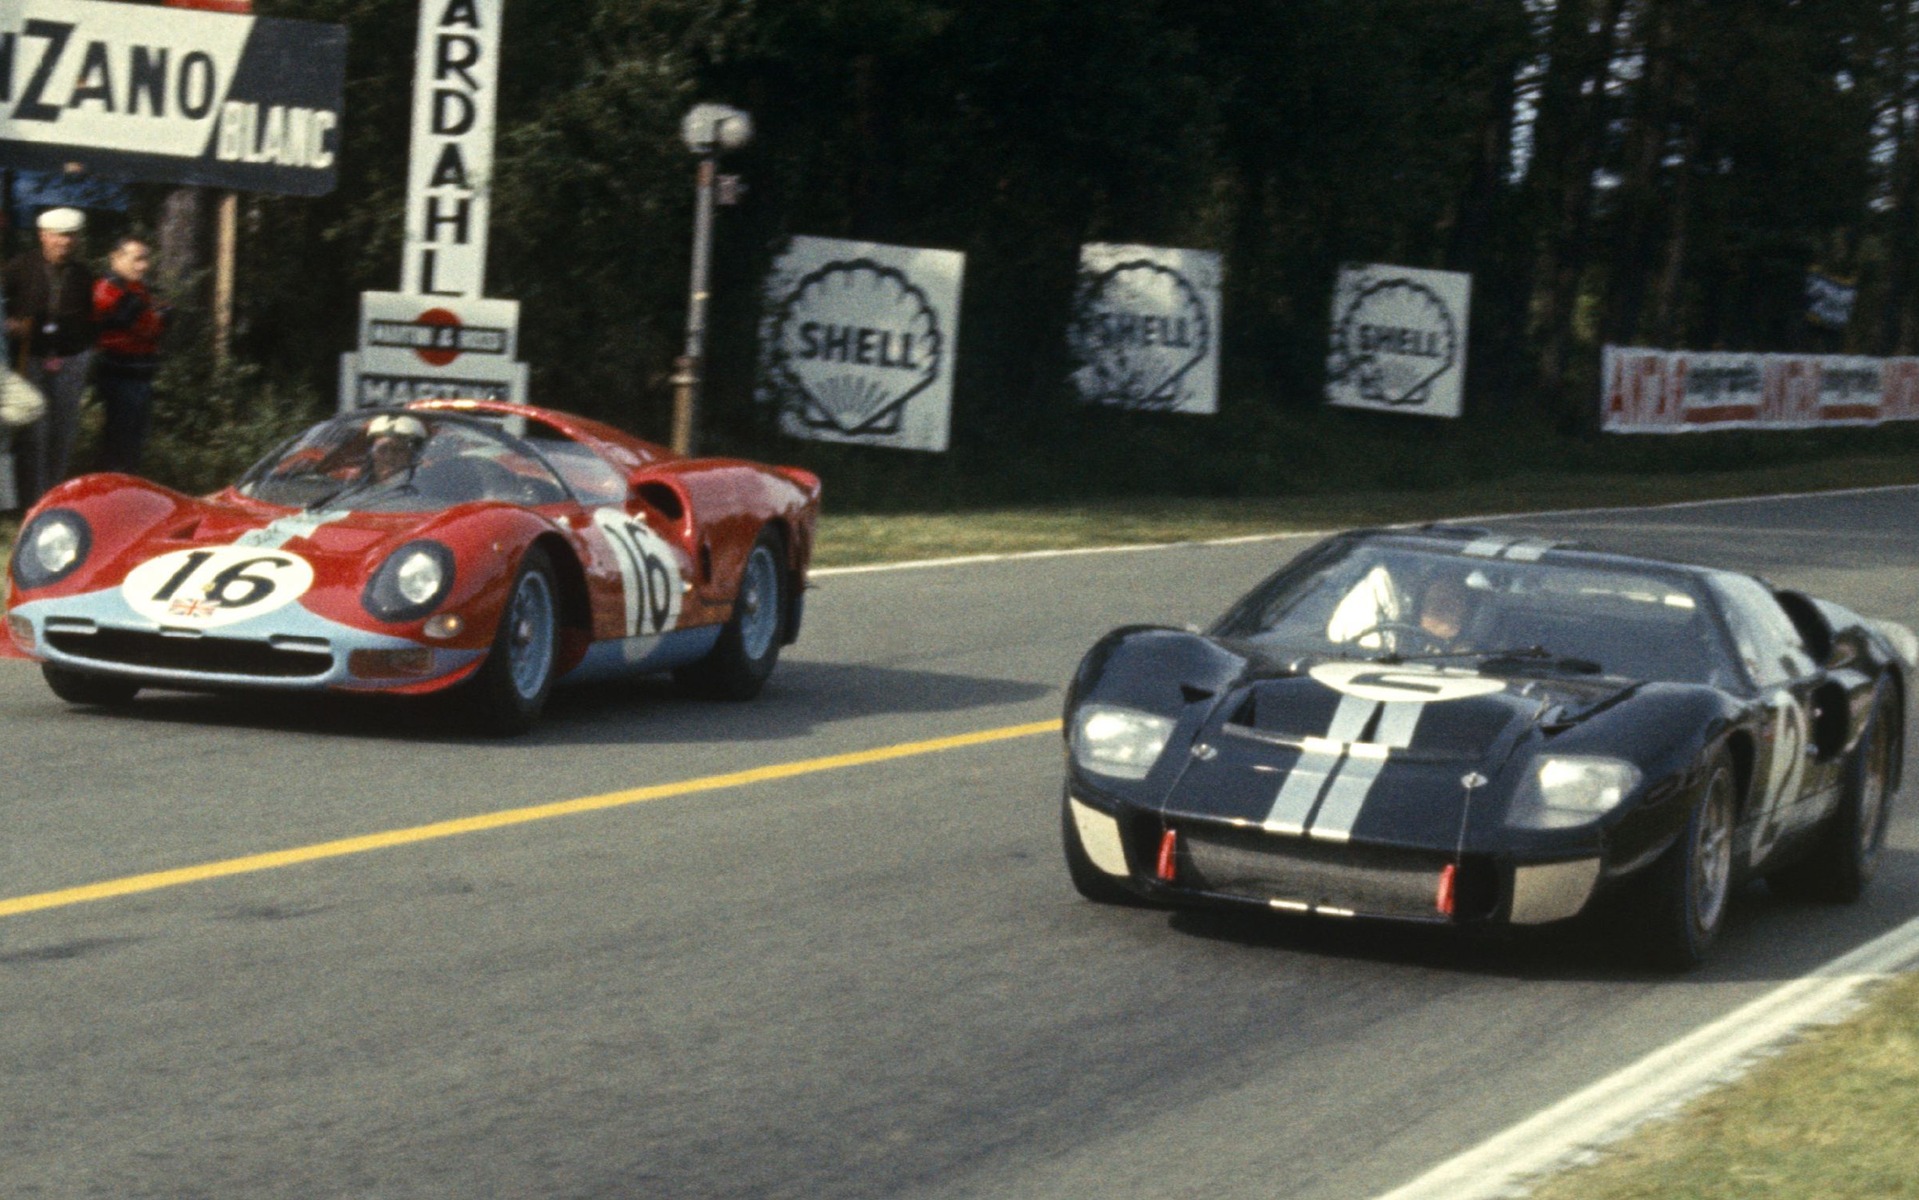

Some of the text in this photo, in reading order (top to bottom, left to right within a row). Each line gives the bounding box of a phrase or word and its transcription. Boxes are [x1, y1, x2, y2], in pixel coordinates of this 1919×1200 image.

[216, 99, 338, 168] BLANC
[800, 321, 919, 370] SHELL
[1359, 323, 1442, 359] SHELL
[151, 550, 294, 608] 16
[603, 522, 671, 637] 16
